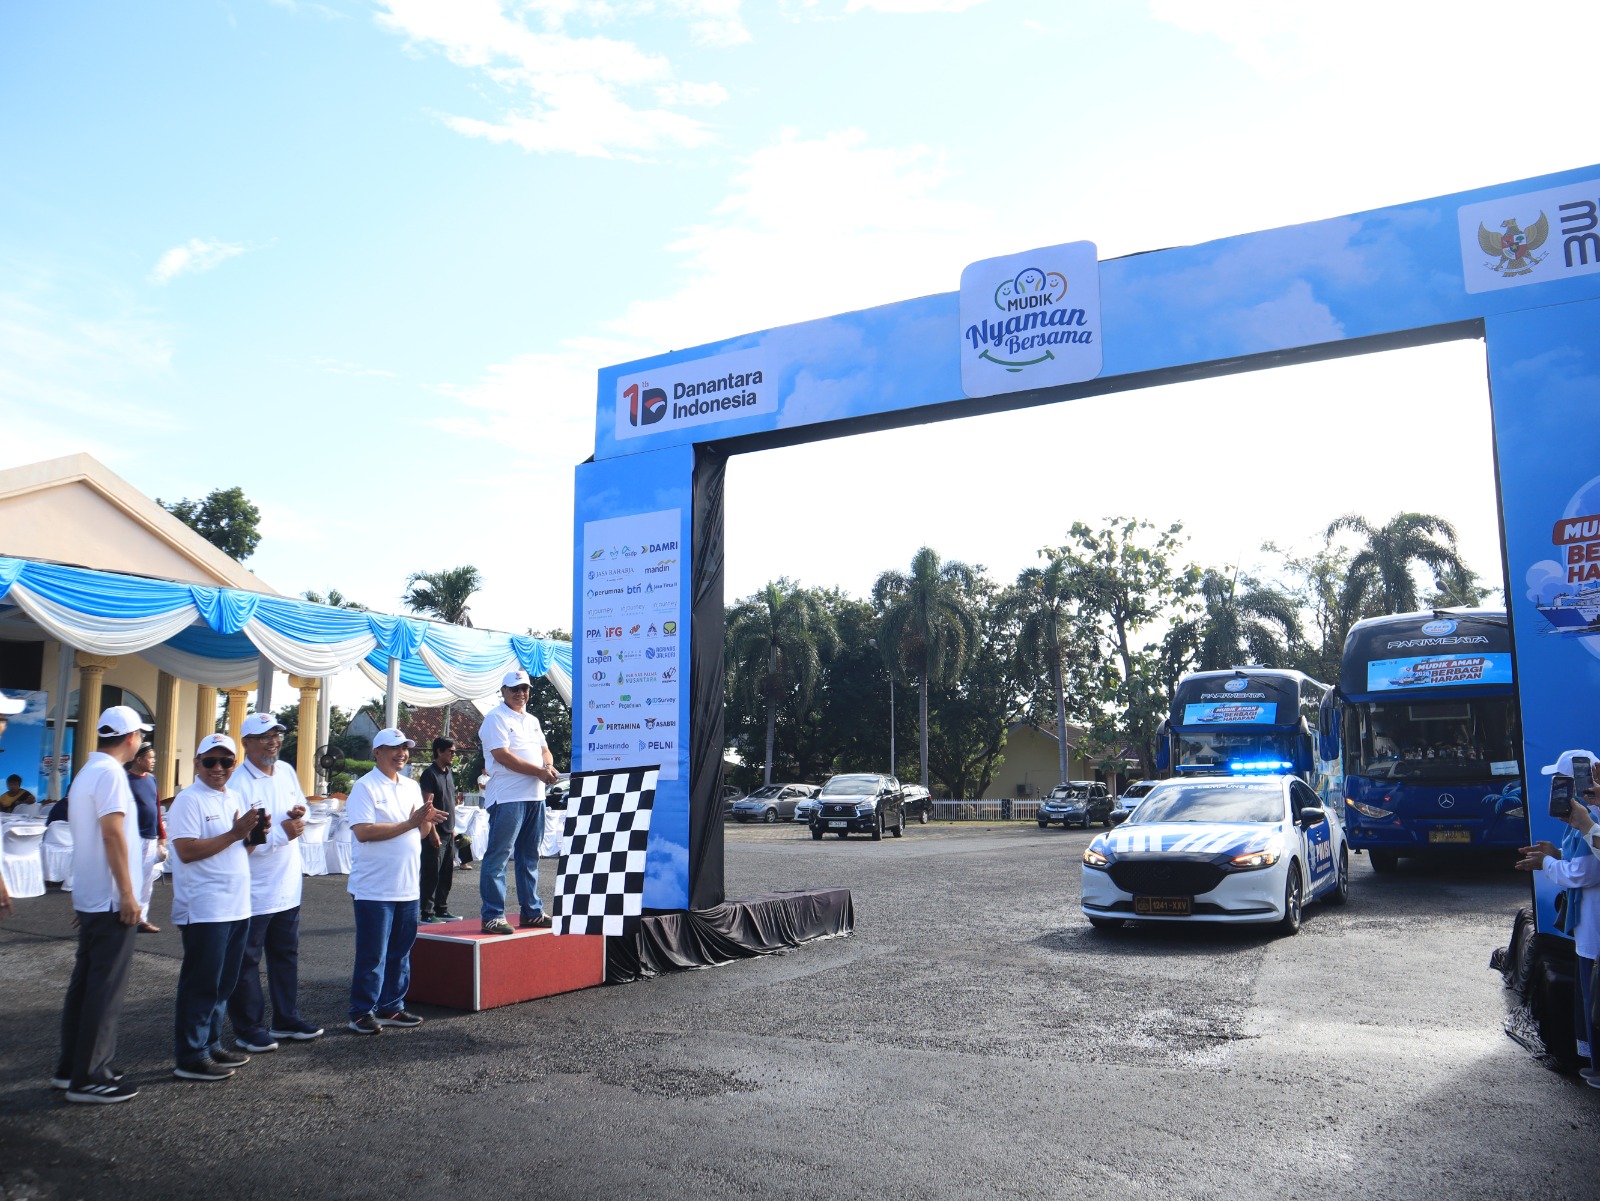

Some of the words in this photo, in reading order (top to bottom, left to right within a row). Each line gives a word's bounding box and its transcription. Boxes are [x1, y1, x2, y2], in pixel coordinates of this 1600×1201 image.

[1007, 293, 1054, 312] MUDIK
[965, 307, 1088, 350] Nyaman
[1004, 329, 1093, 355] Bersama
[673, 370, 763, 400] Danantara
[672, 389, 757, 420] Indonesia
[649, 541, 678, 553] DAMRI
[595, 587, 624, 597] perumnas
[626, 585, 642, 595] btn
[586, 629, 601, 638] PPA
[1387, 635, 1489, 650] PARIWISATA
[587, 655, 612, 665] taspen
[1417, 661, 1449, 671] MUDIK
[1450, 658, 1481, 667] AMAN
[1431, 665, 1484, 677] BERBAGI
[1430, 673, 1482, 684] HARAPAN
[606, 723, 641, 731] PERTAMINA
[595, 742, 630, 750] Jamkrindo
[647, 741, 674, 750] PELNI
